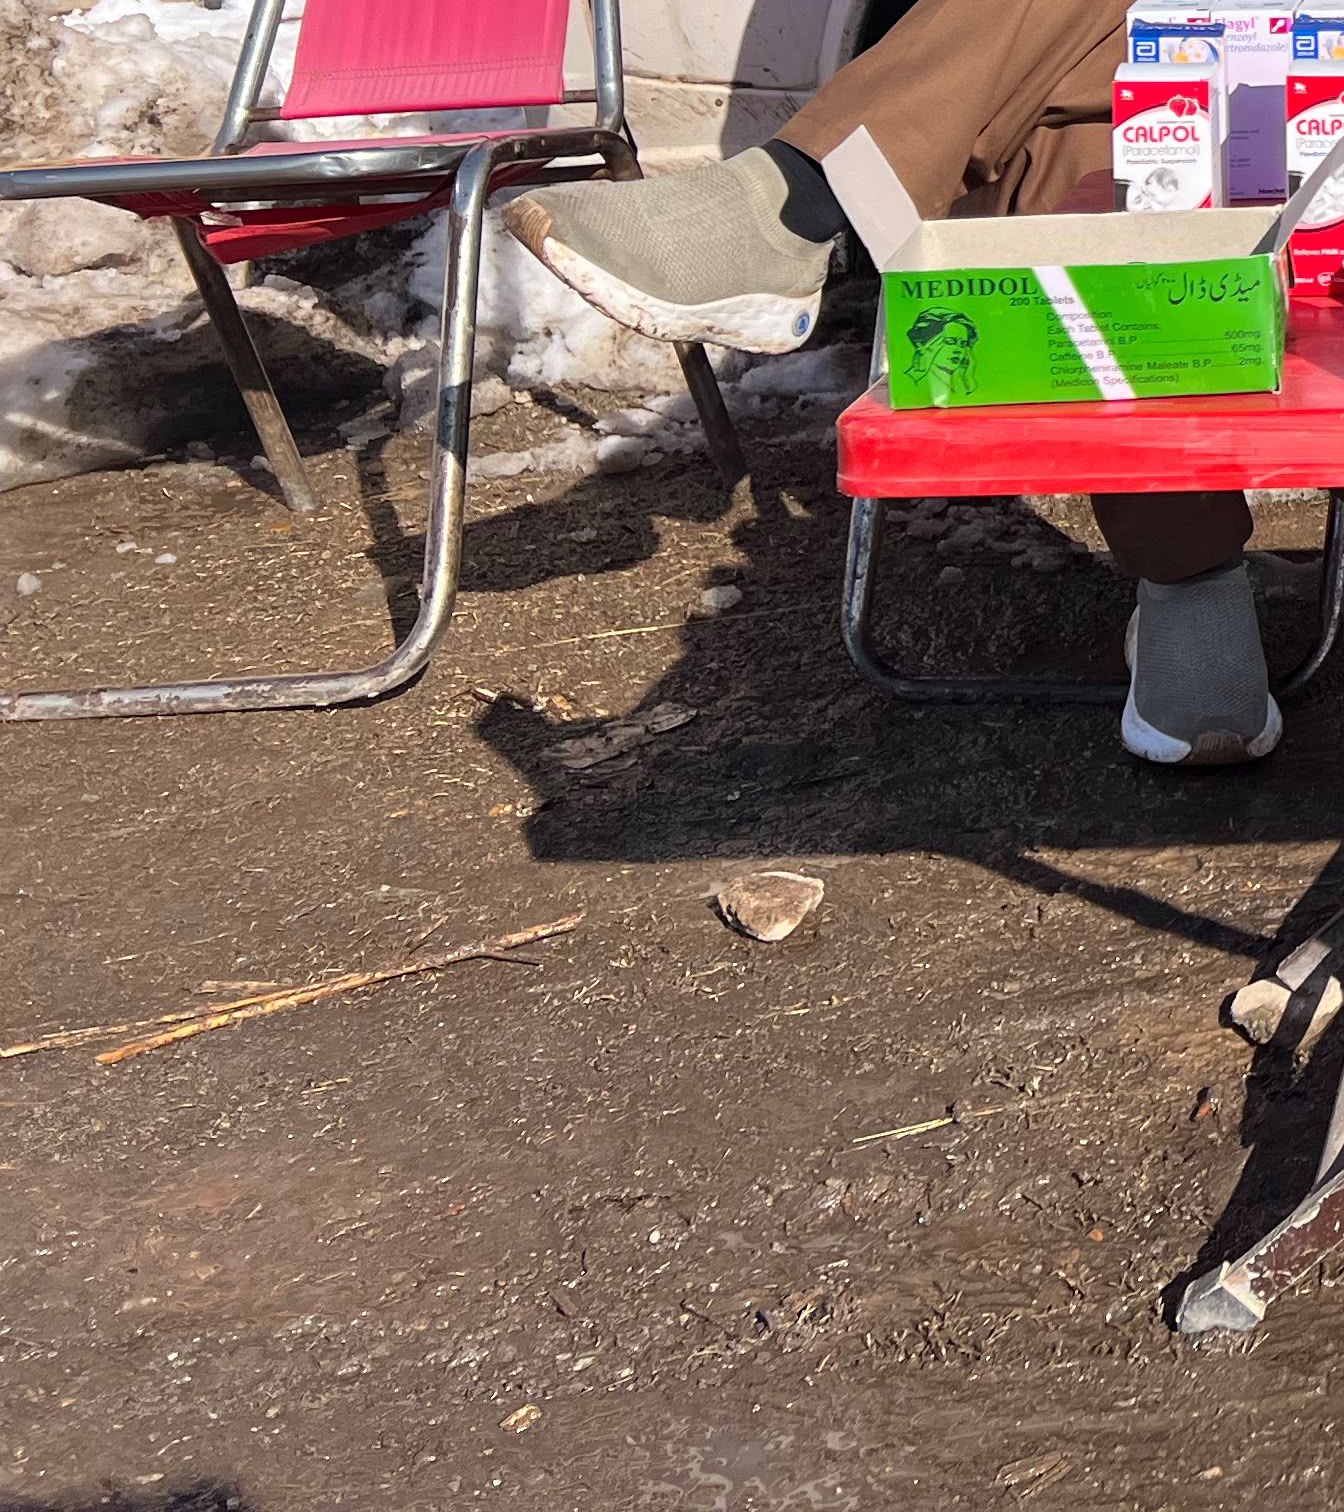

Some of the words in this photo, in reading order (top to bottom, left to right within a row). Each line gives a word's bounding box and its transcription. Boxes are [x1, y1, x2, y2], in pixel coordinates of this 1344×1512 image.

[1122, 126, 1201, 143] CALPOL
[1122, 145, 1201, 157] (Paracetamol)
[899, 276, 1039, 300] MEDIDOL
[1168, 272, 1206, 305] ڈال
[1209, 272, 1262, 303] میڈی
[1009, 295, 1031, 306] 200
[1033, 294, 1075, 306] Tablets
[1047, 324, 1073, 335] Each
[1075, 323, 1109, 333] Tablet
[1048, 335, 1114, 348] Paracetamol
[1049, 350, 1094, 362] Caffeine
[1103, 373, 1180, 386] Specifications)
